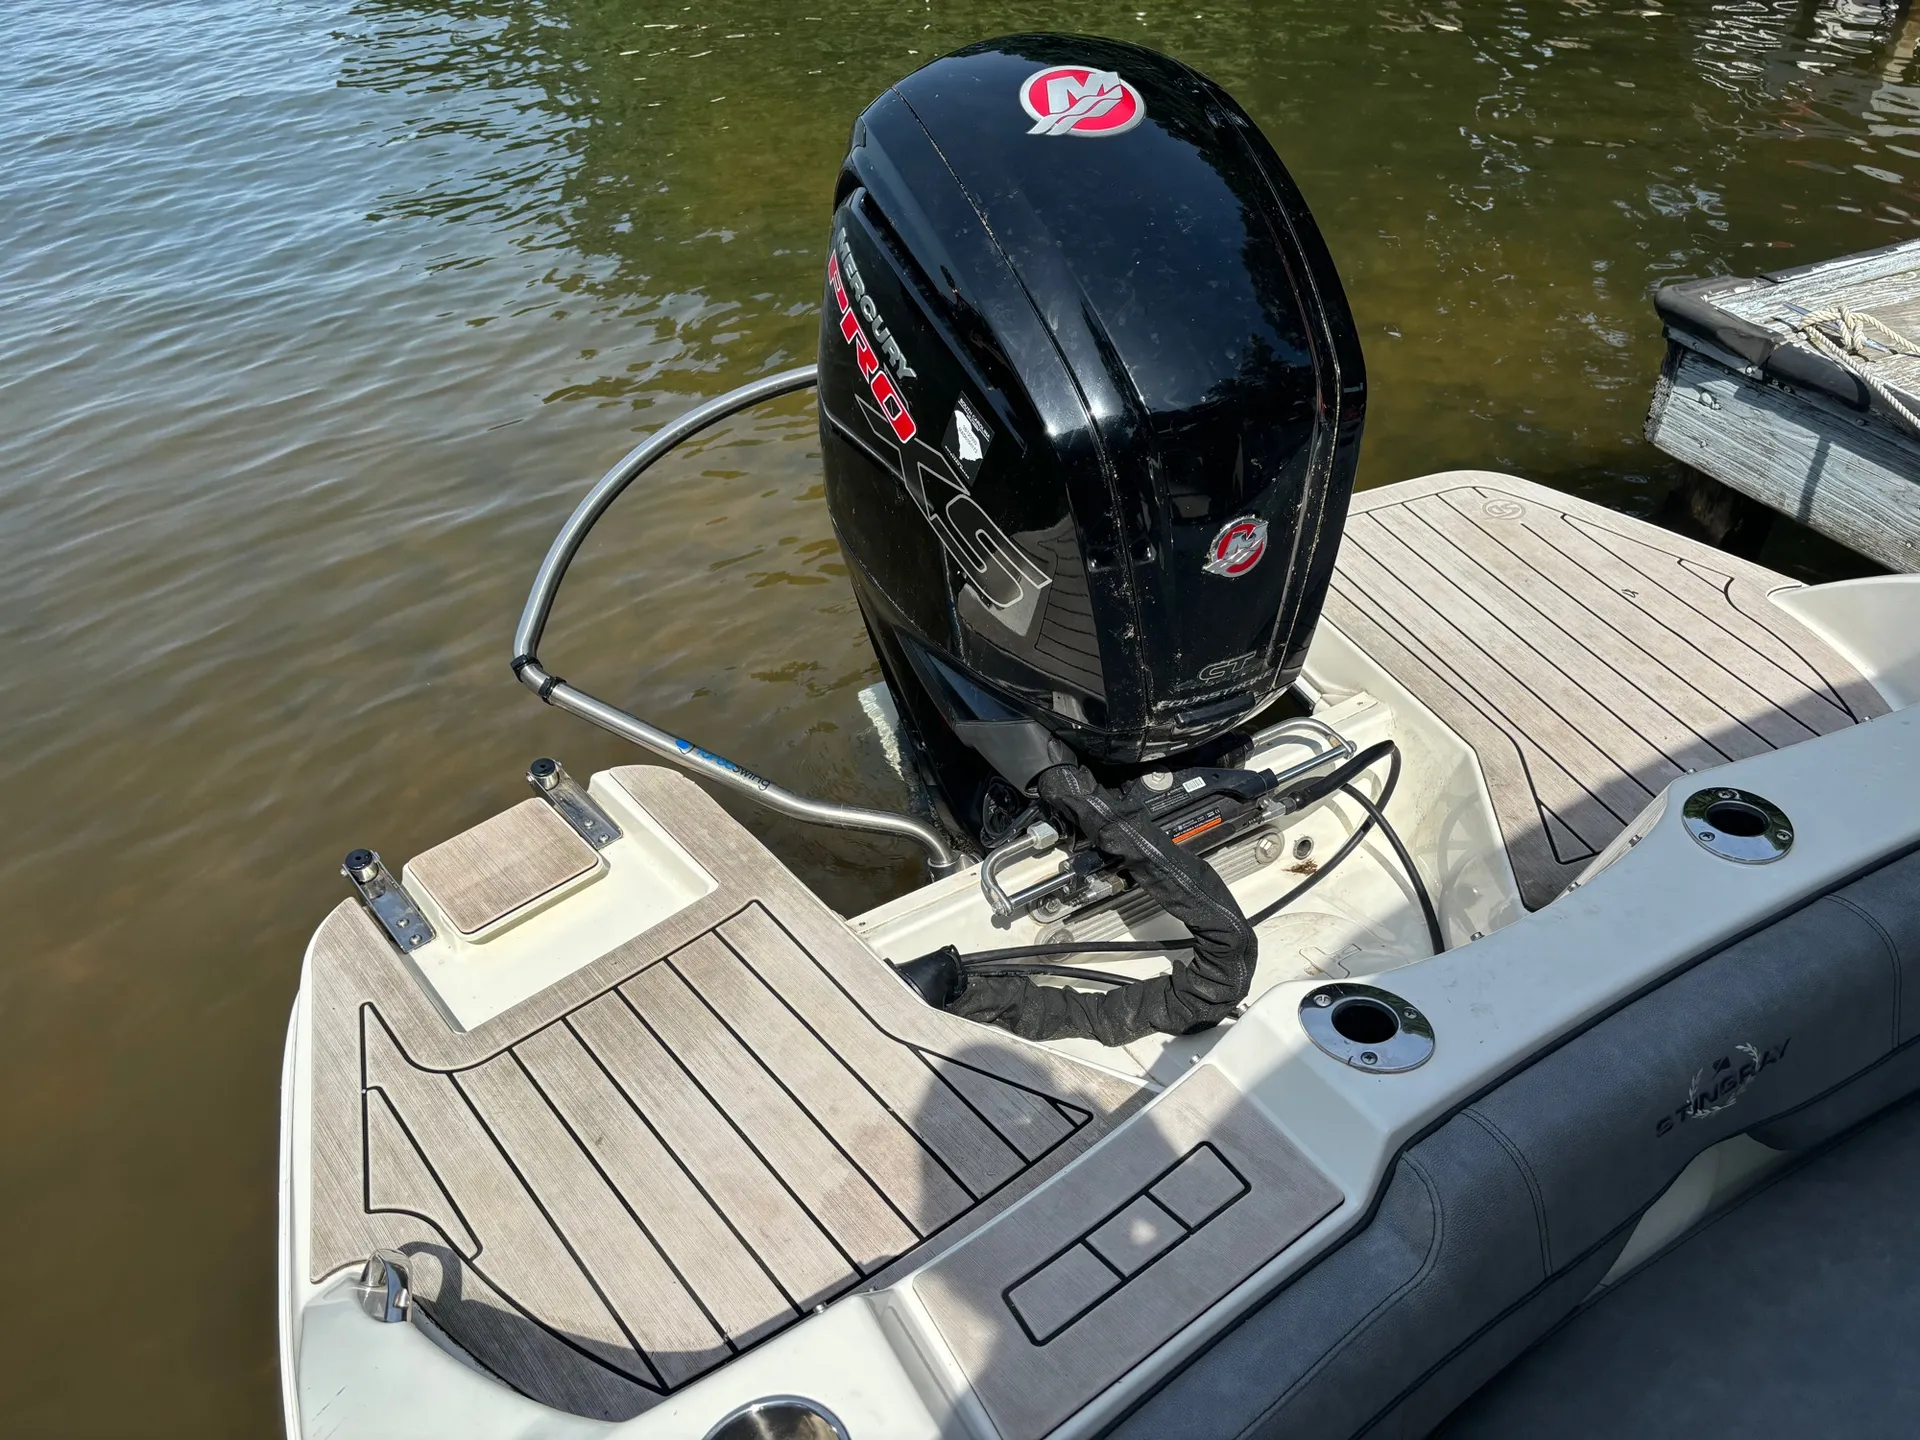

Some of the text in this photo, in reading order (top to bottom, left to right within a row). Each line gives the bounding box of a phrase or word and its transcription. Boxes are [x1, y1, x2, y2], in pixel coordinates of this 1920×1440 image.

[828, 248, 917, 444] PRO
[837, 227, 917, 380] MERCURY
[1655, 1036, 1792, 1138] STINGRAY
